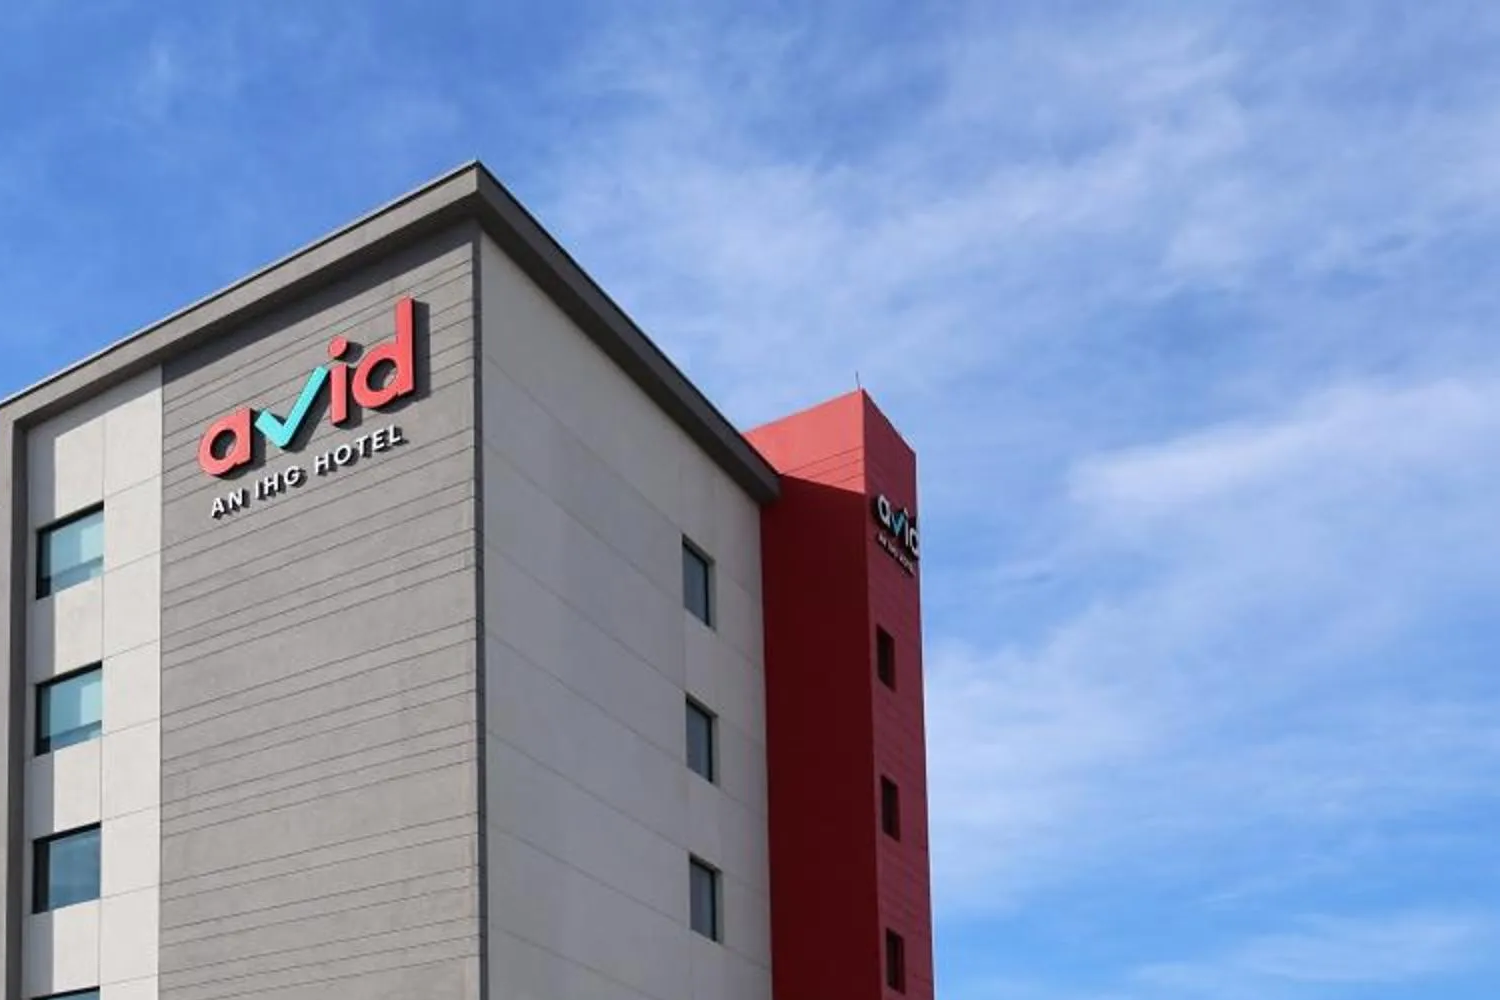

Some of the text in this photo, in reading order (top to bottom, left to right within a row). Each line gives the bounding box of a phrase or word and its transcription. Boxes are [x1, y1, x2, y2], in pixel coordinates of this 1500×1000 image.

[197, 295, 415, 476] avid
[211, 423, 402, 517] AN IHG HOTEL
